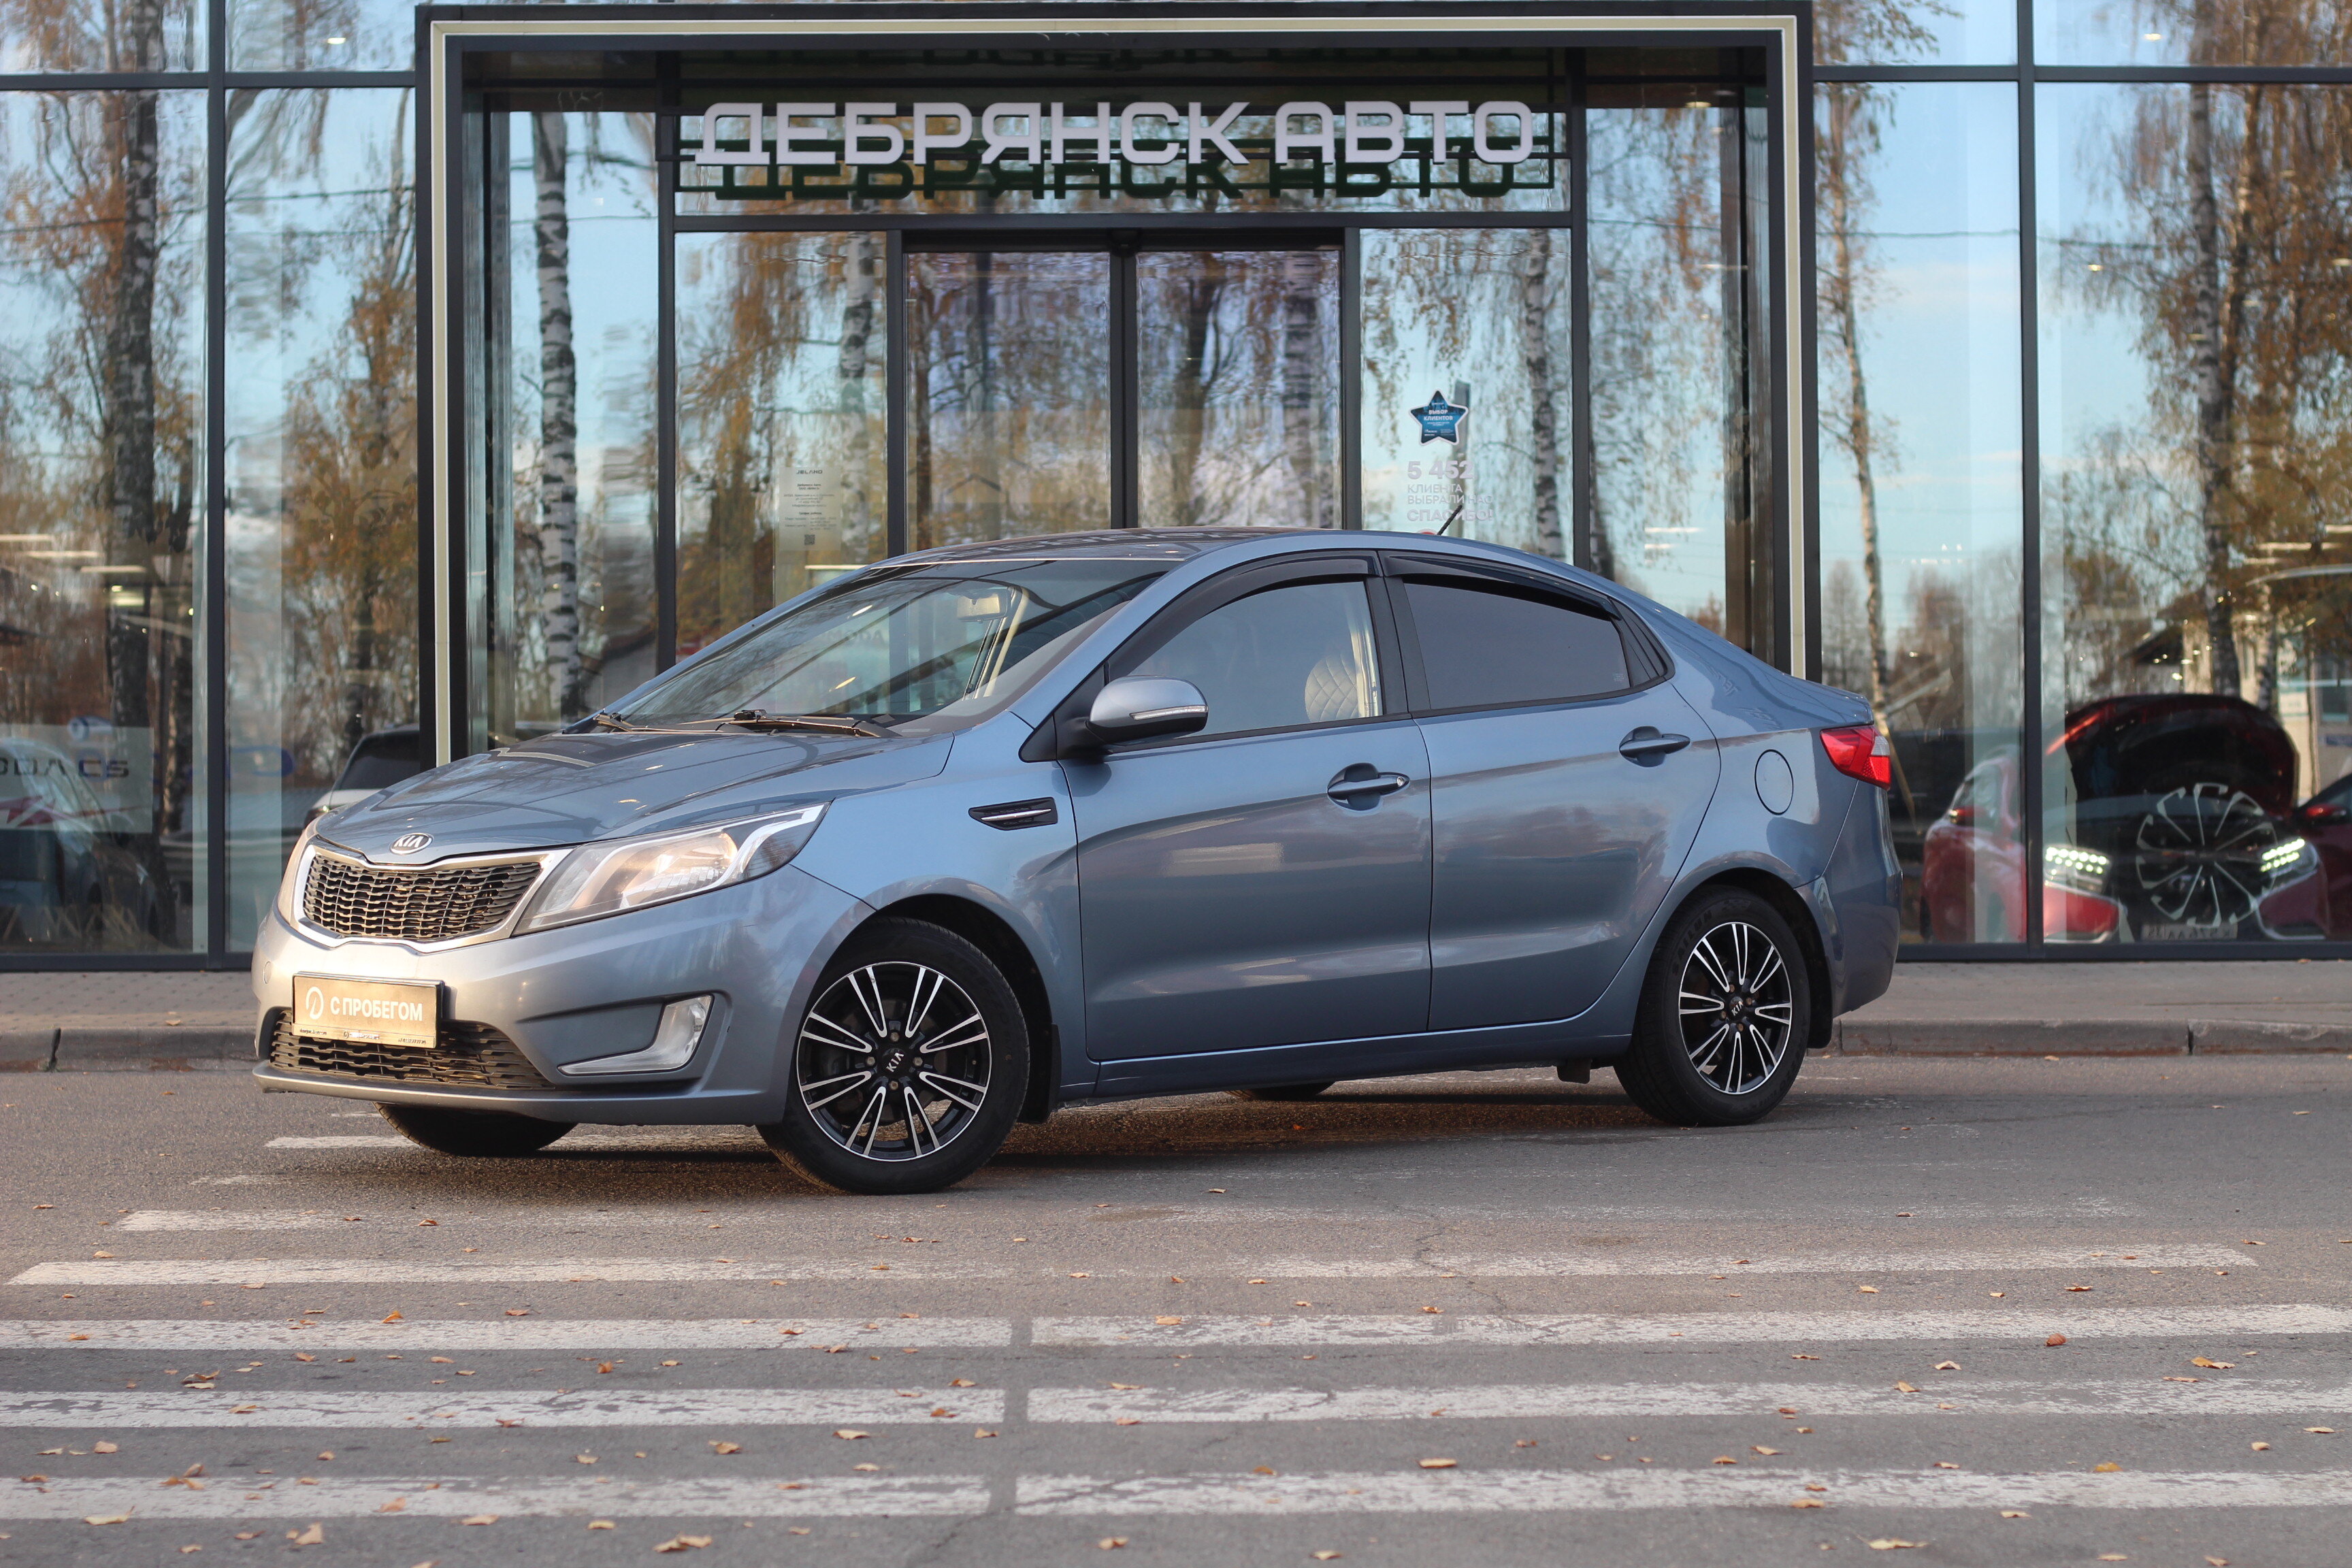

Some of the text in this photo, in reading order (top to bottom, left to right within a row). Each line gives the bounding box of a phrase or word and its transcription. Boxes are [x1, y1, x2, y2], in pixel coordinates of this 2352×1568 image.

[695, 100, 1534, 165] ДЕБРЯНСК АВТО
[1407, 460, 1475, 479] 5 452
[1407, 484, 1463, 493] КЛИЕНТА
[1407, 494, 1493, 504] ВЫБРАЛИ НАС
[393, 835, 425, 848] KIA
[329, 996, 423, 1022] С ПРОБЕГОМ
[885, 1052, 904, 1073] KIA
